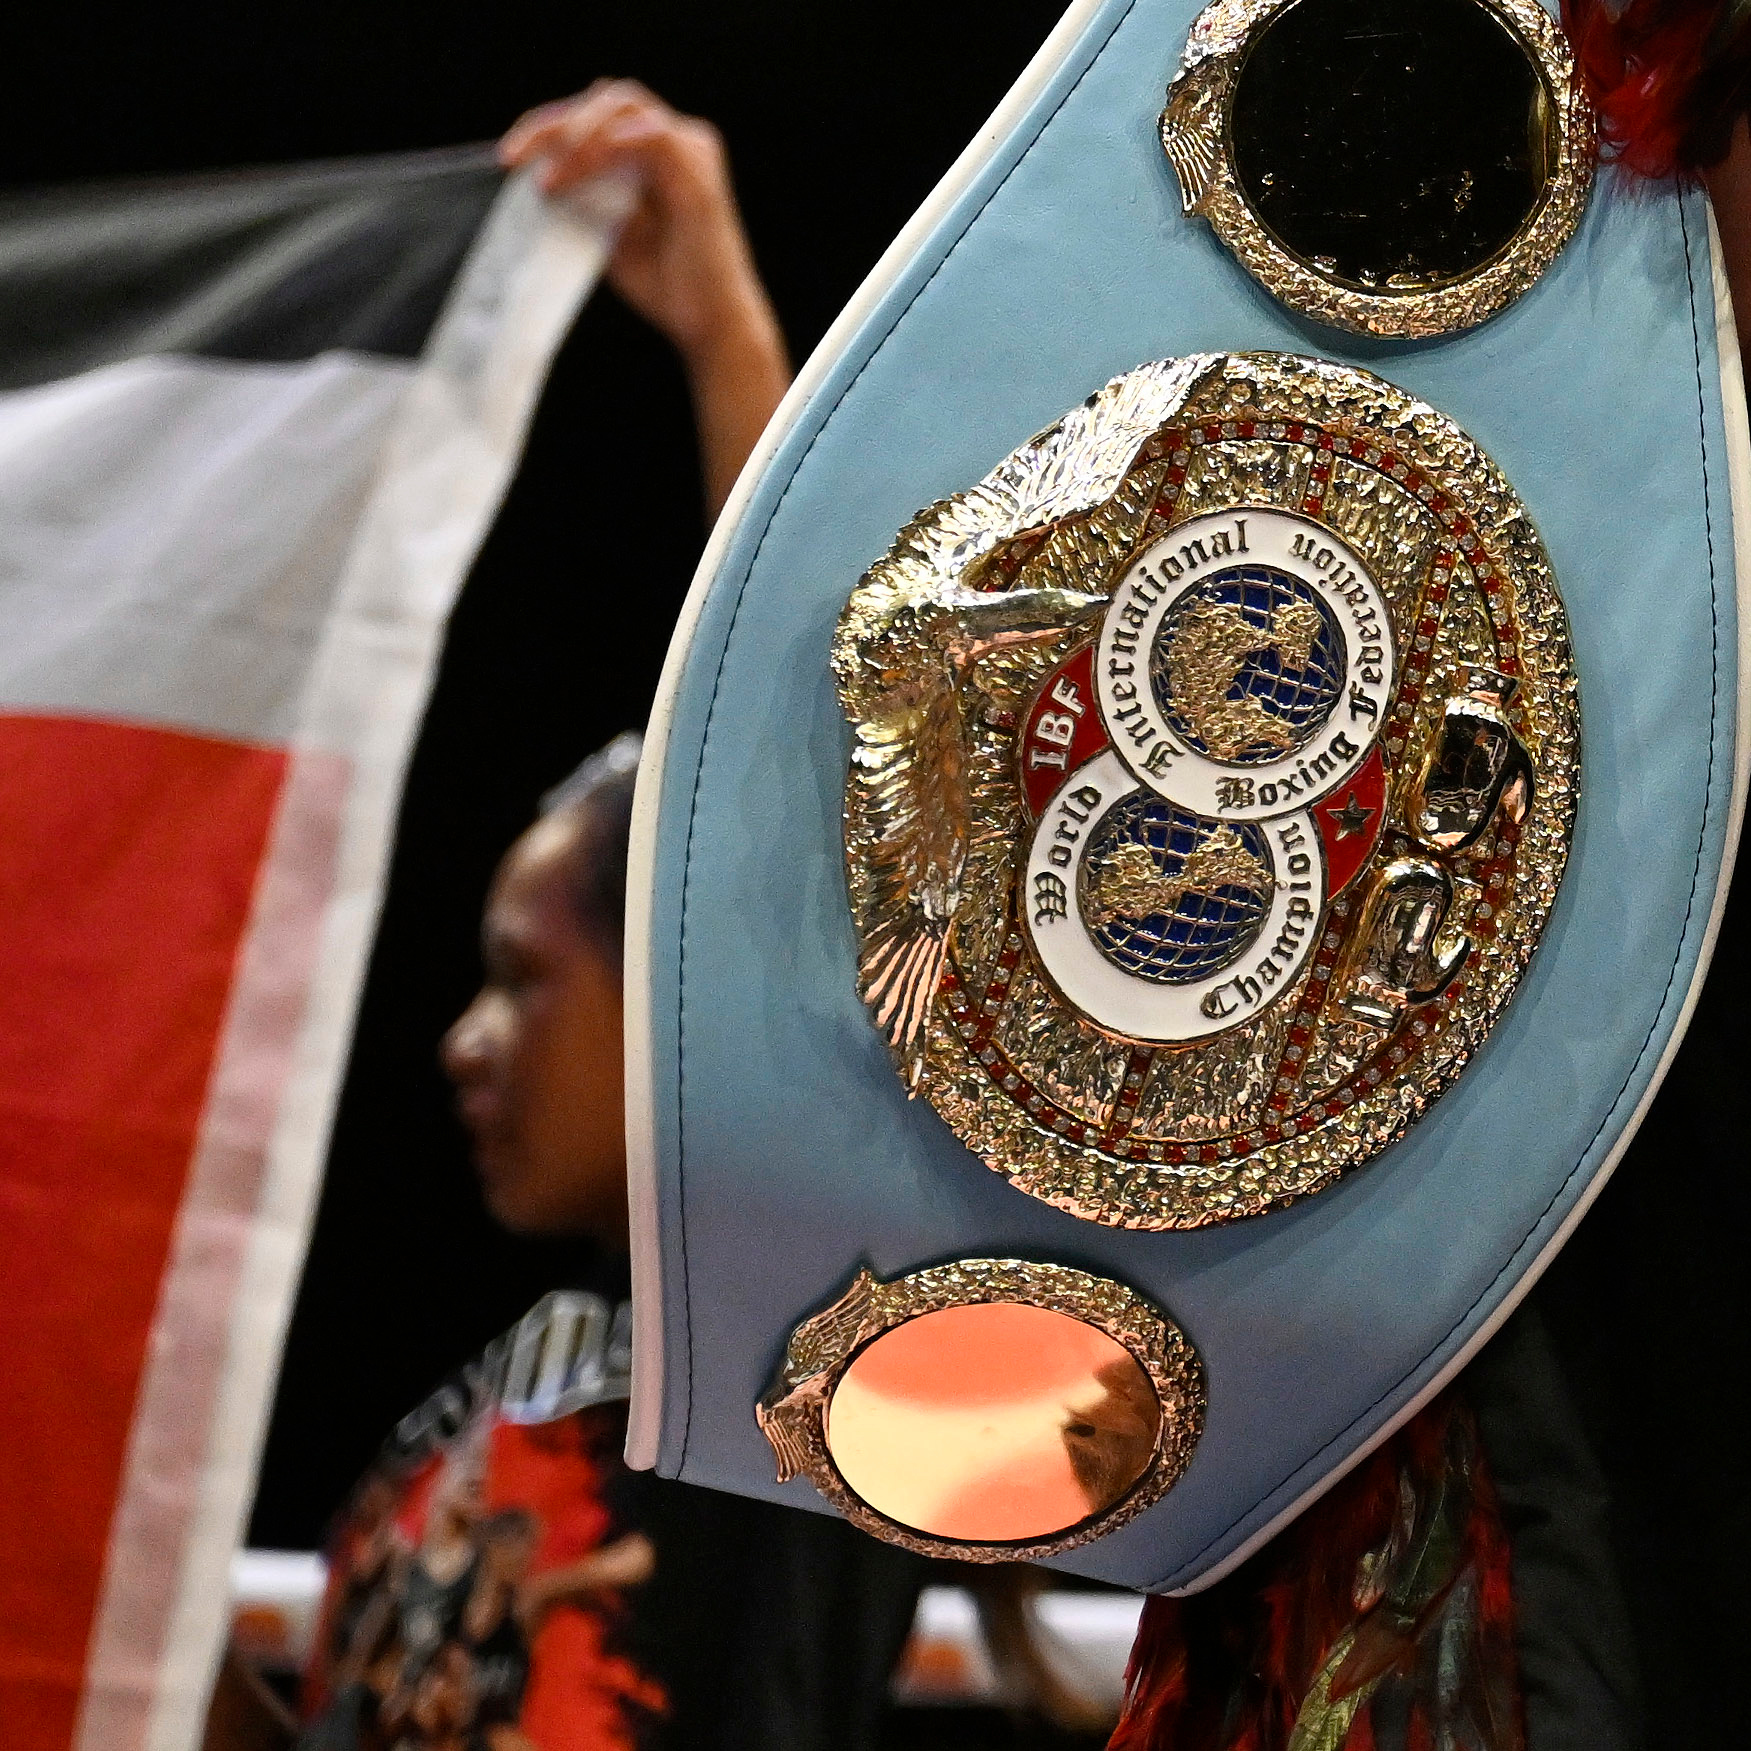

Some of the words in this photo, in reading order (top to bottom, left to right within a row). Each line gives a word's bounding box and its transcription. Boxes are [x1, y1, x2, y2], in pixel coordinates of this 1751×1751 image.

[1030, 677, 1086, 772] IBF
[1111, 519, 1250, 780] International
[1215, 731, 1360, 813] Boxing
[1292, 532, 1383, 732] Federation
[1033, 785, 1103, 927] World
[1199, 822, 1315, 1020] Champion
